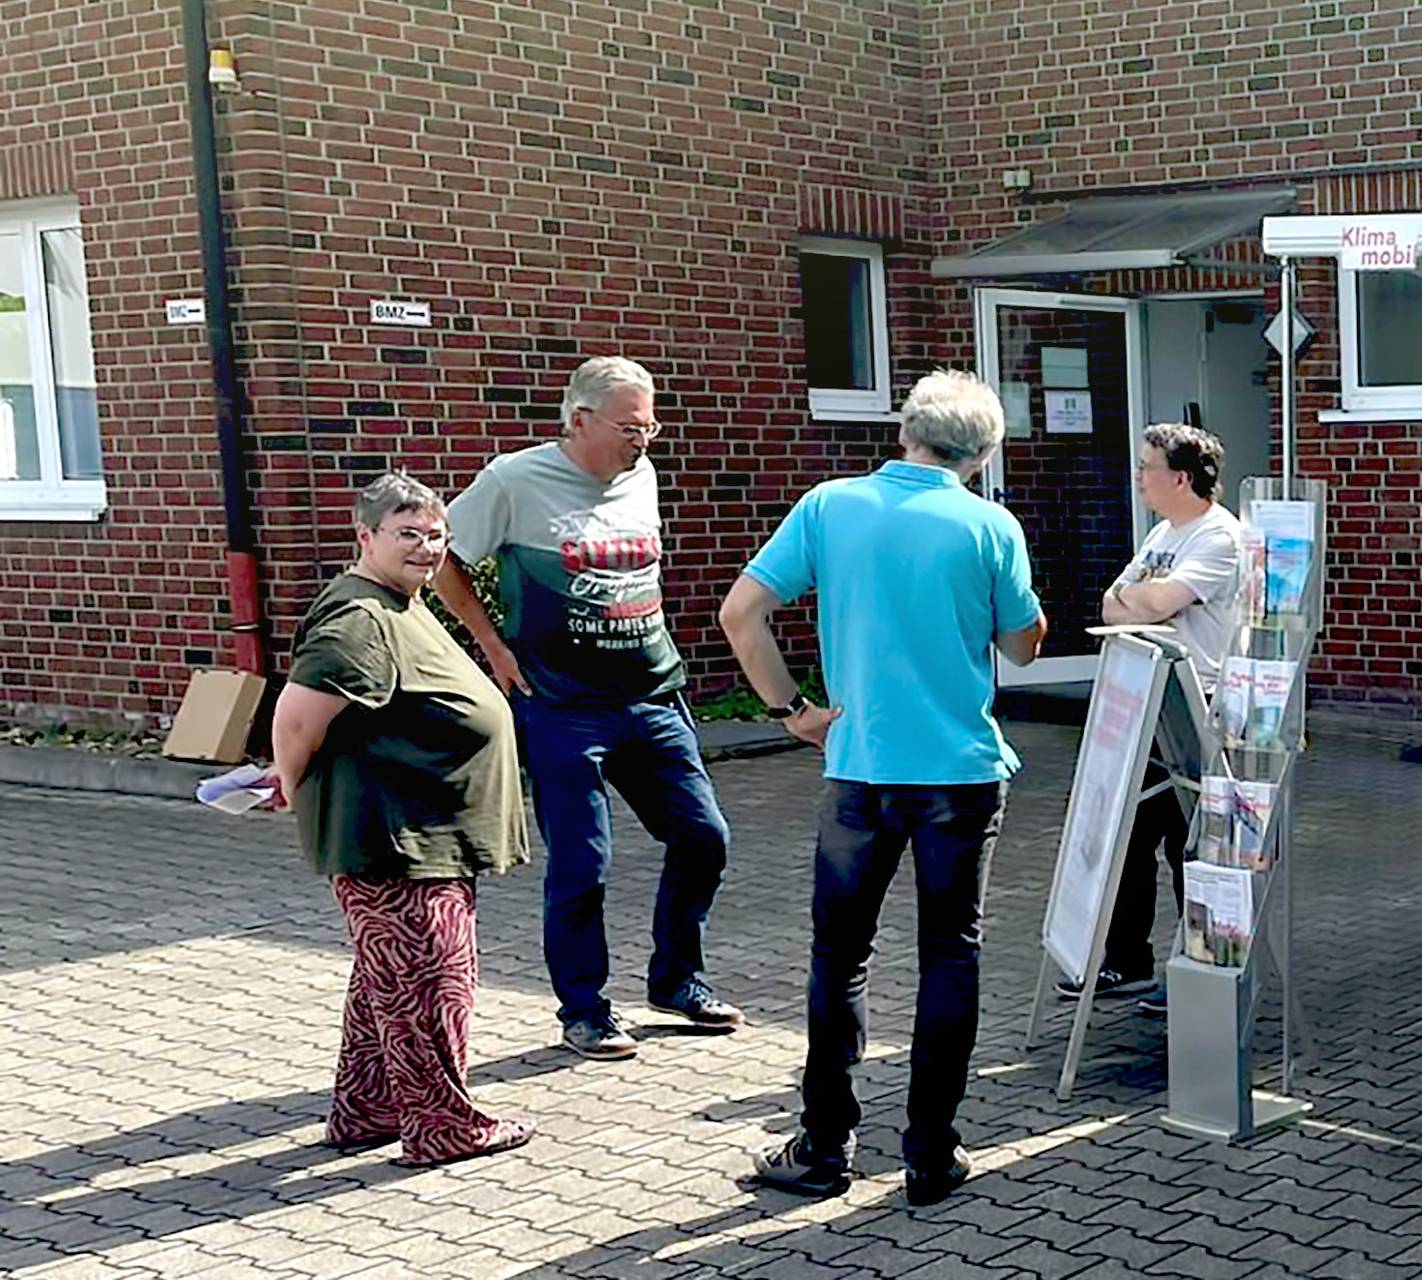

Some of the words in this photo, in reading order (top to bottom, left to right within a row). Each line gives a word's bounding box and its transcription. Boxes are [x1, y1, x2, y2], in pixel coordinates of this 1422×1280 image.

[1342, 226, 1396, 246] Klima
[1361, 244, 1419, 265] mobil
[375, 304, 405, 319] BMZ
[568, 619, 606, 634] SOME
